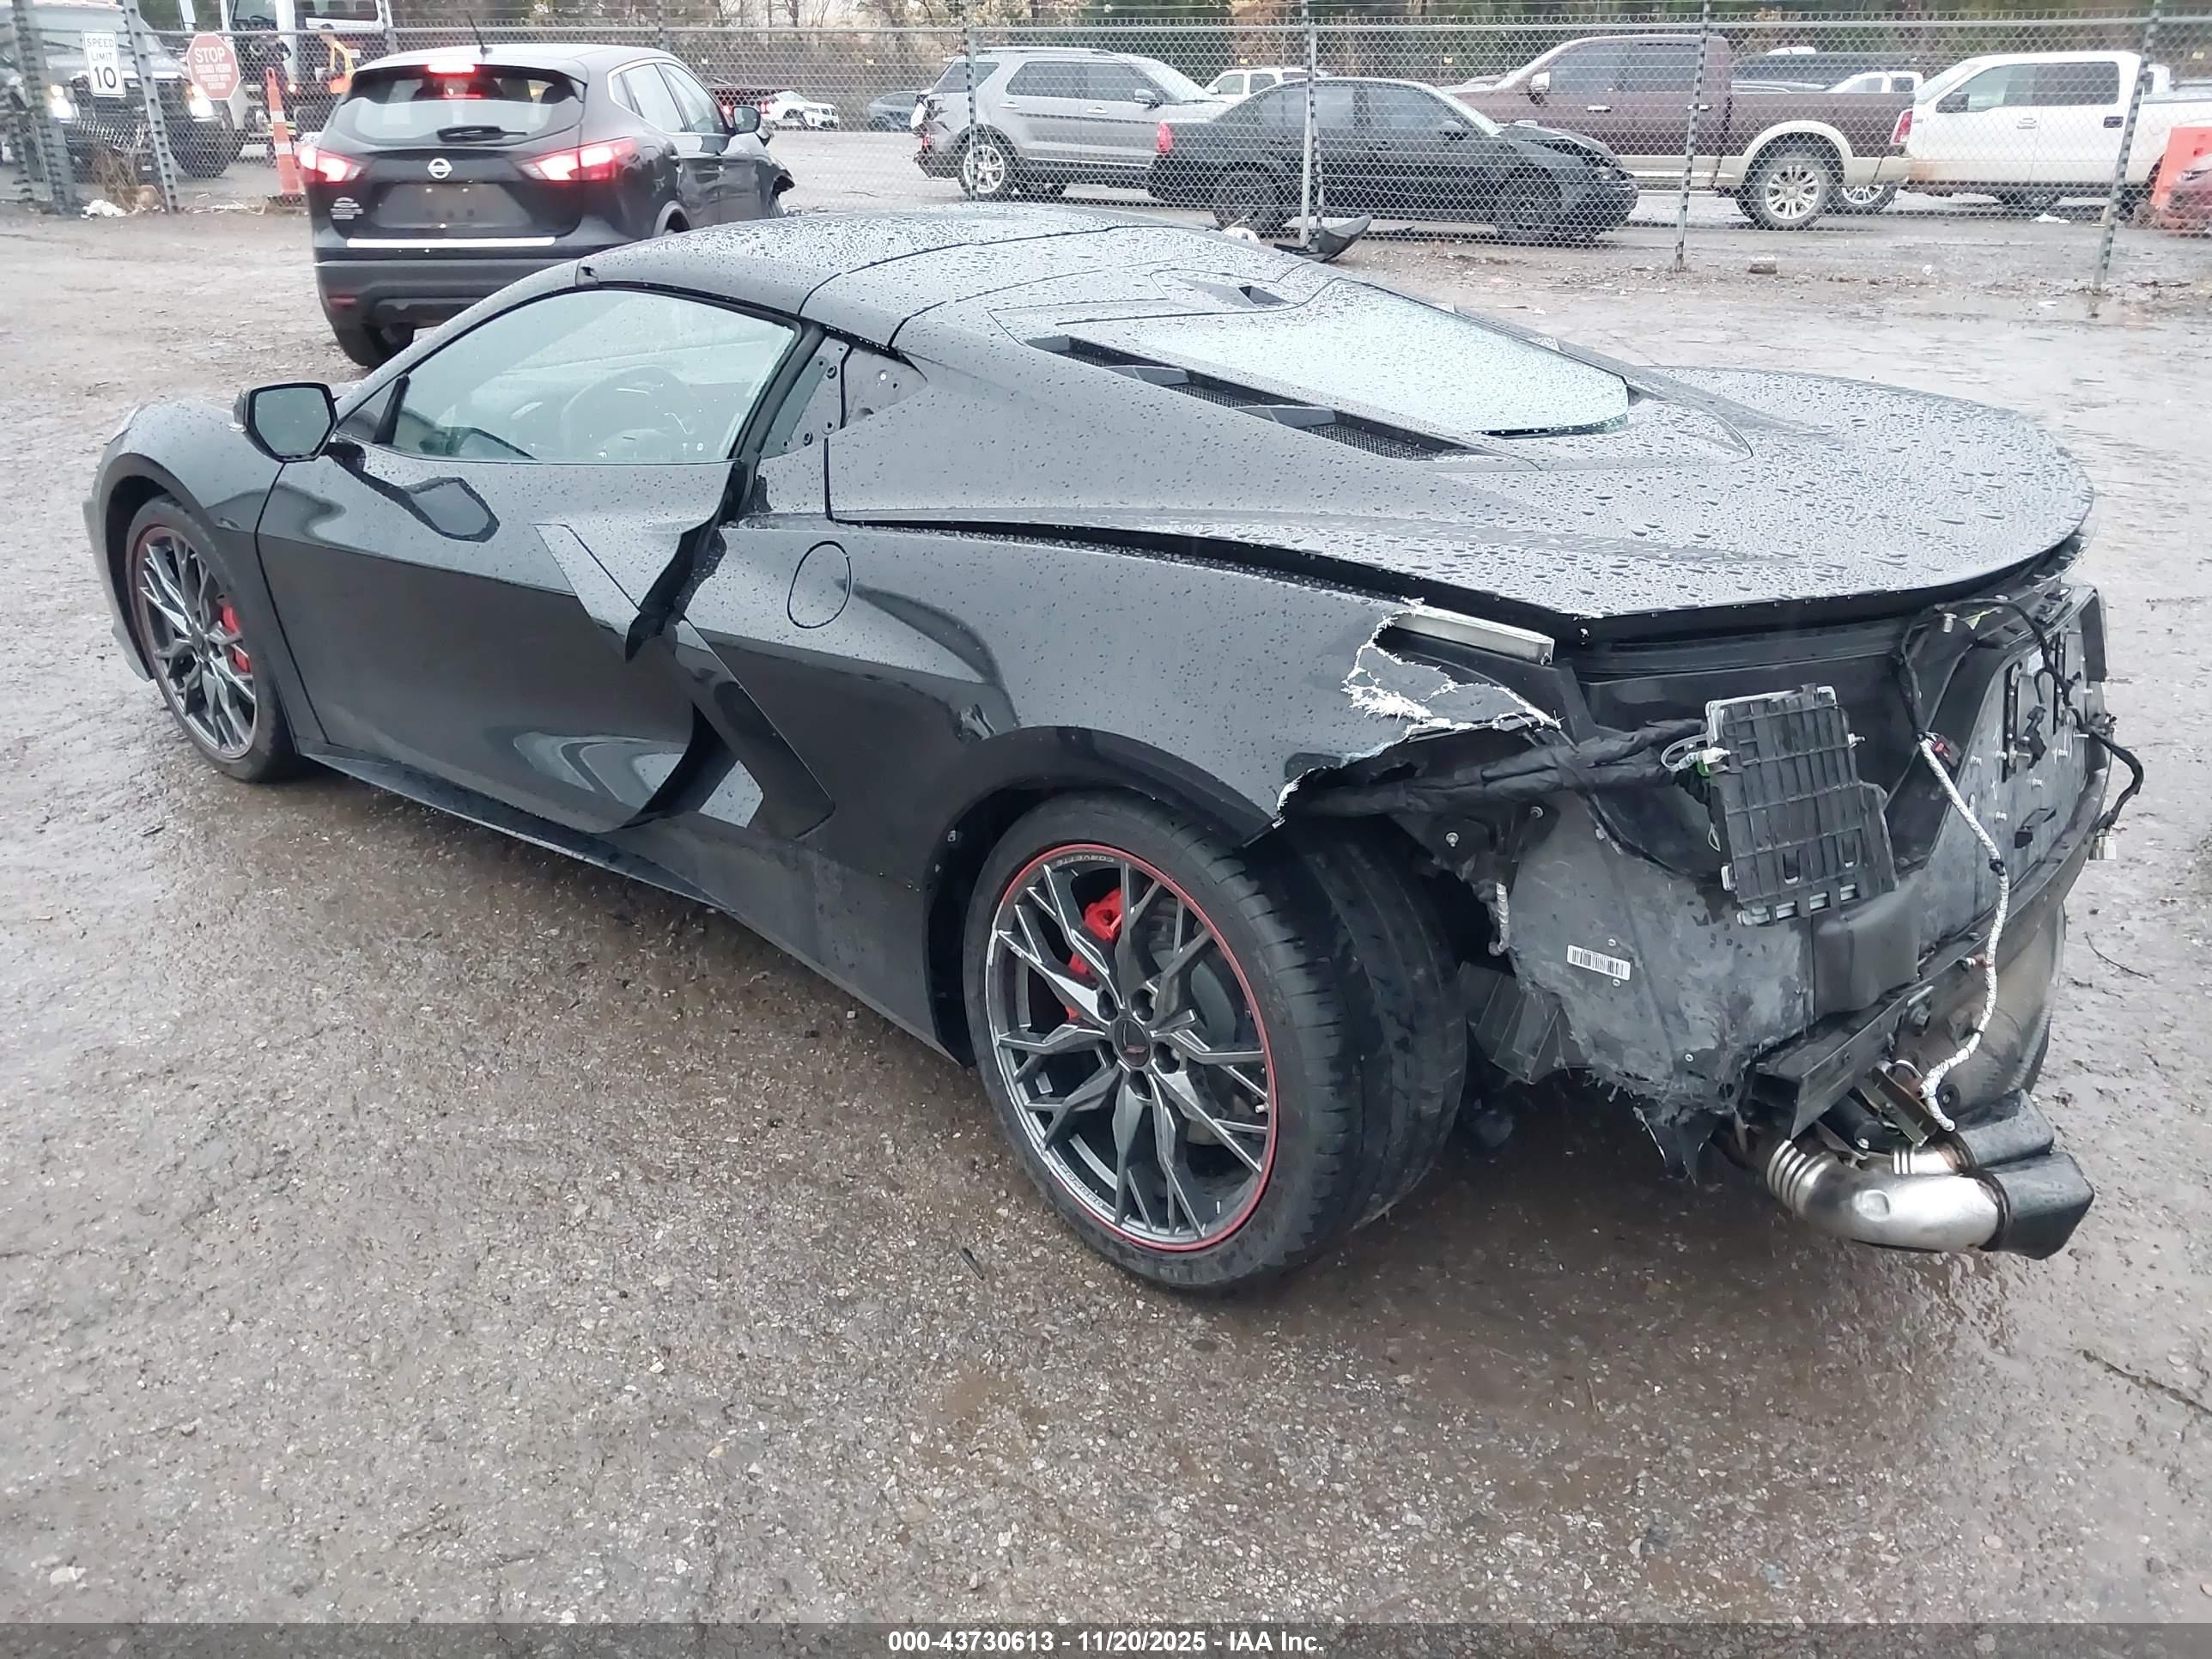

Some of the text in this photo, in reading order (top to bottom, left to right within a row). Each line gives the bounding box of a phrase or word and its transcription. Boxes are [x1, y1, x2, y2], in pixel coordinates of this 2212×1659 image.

[87, 38, 114, 48] SPEED
[91, 52, 112, 62] LIMIT
[194, 46, 226, 64] STOP
[94, 66, 117, 89] 10
